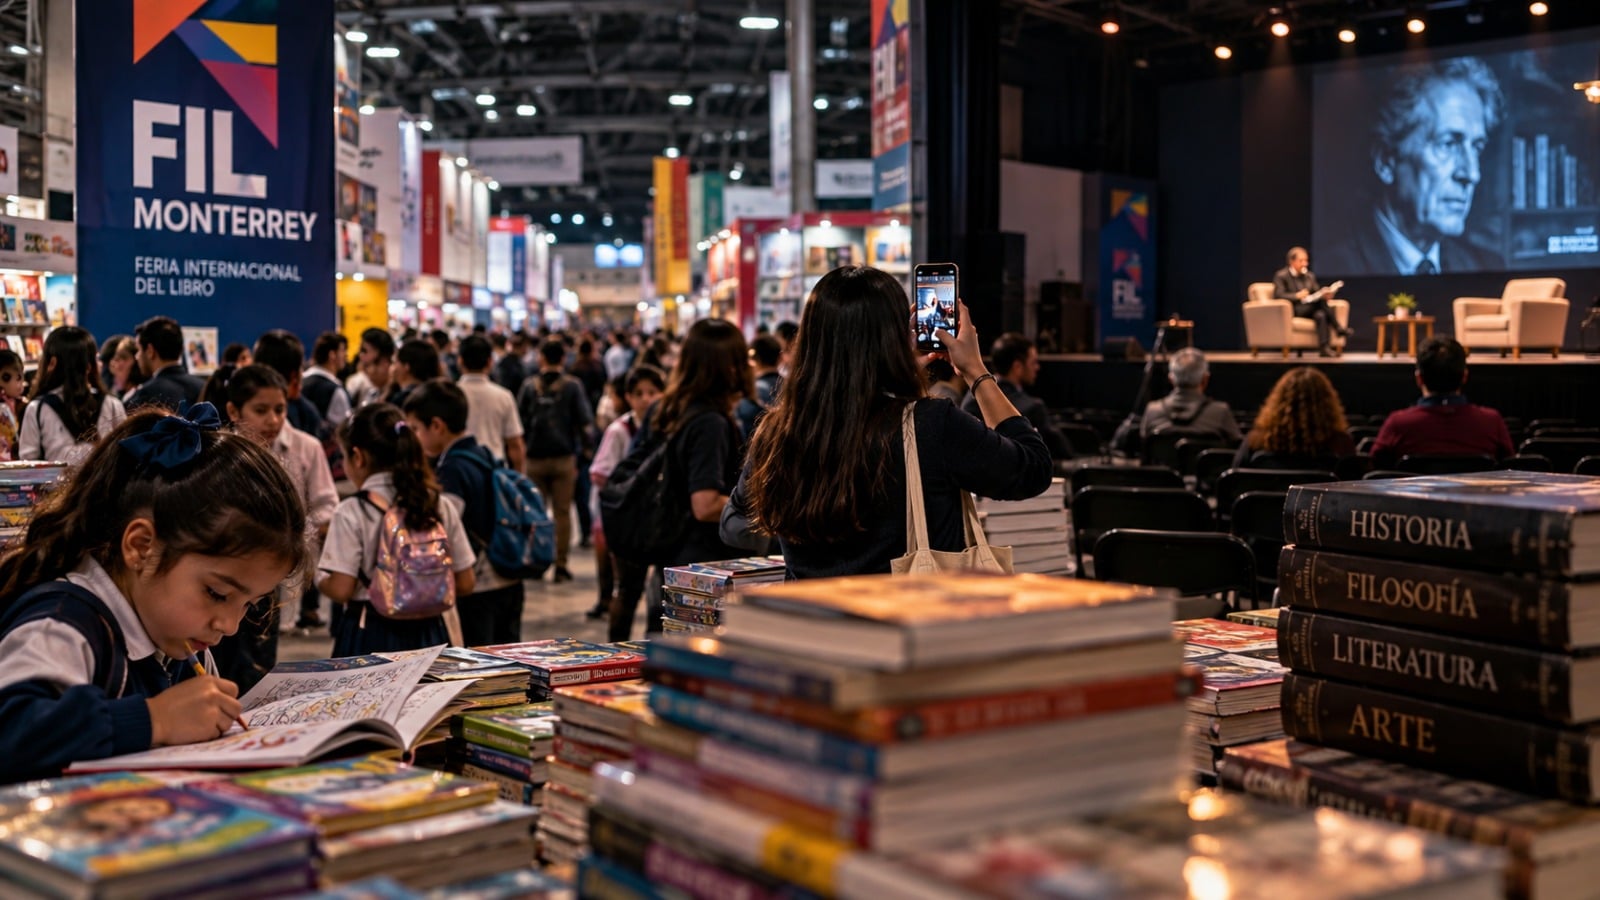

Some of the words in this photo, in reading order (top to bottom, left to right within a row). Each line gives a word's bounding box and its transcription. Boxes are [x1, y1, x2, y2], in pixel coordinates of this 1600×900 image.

[133, 100, 267, 199] FIL
[134, 197, 317, 242] MONTERREY
[135, 256, 180, 276] FERIA
[184, 259, 302, 282] INTERNACIONAL
[135, 278, 165, 296] DEL
[169, 280, 215, 297] LIBRO
[1350, 510, 1472, 551] HISTORIA
[1347, 572, 1478, 619] FILOSOFÍA
[1332, 633, 1499, 692] LITERATURA
[1349, 704, 1436, 753] ARTE
